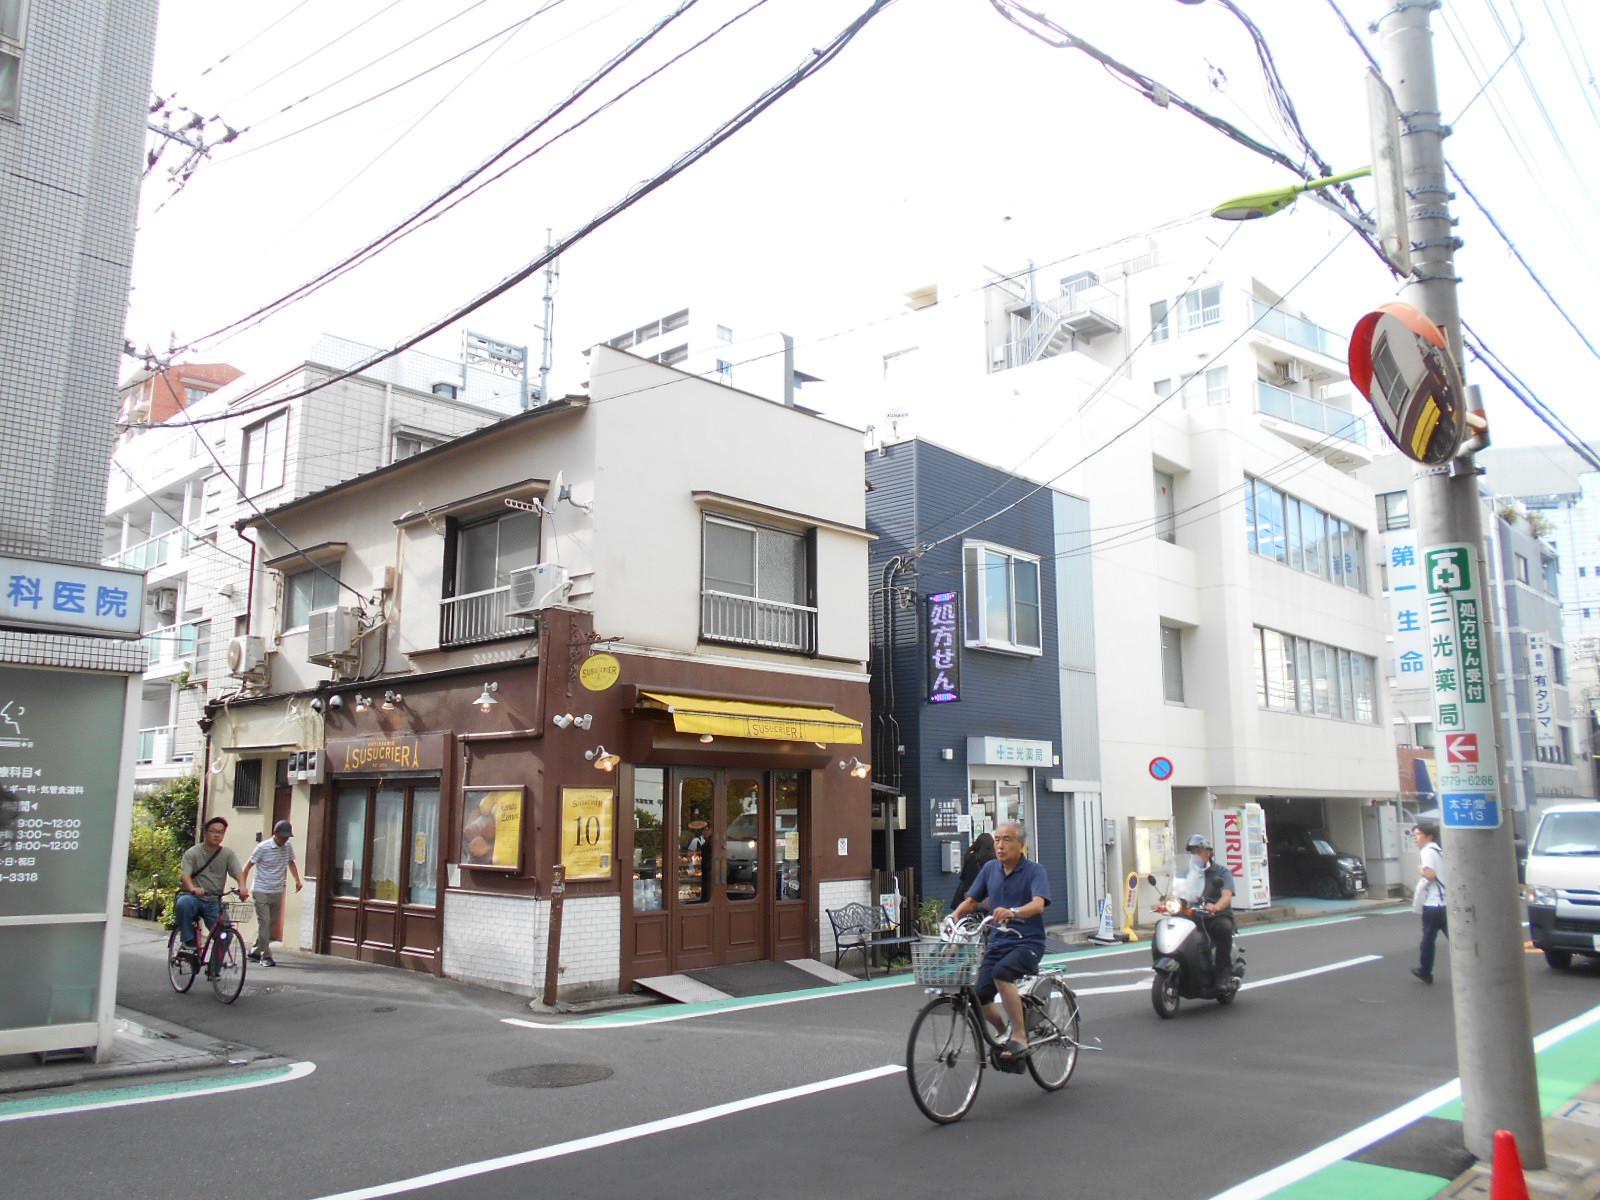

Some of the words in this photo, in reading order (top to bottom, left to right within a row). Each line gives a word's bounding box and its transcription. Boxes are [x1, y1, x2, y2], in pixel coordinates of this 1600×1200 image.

[6, 575, 129, 618] 科医院
[1392, 546, 1424, 672] 第一生命
[931, 604, 955, 690] 処方せん
[1429, 600, 1458, 726] 三光薬局
[1459, 602, 1484, 700] 処方せん受付
[352, 745, 410, 769] SUSUCRIER
[573, 815, 600, 847] 10
[1224, 814, 1243, 878] KIRIN
[1453, 810, 1485, 822] 1-13
